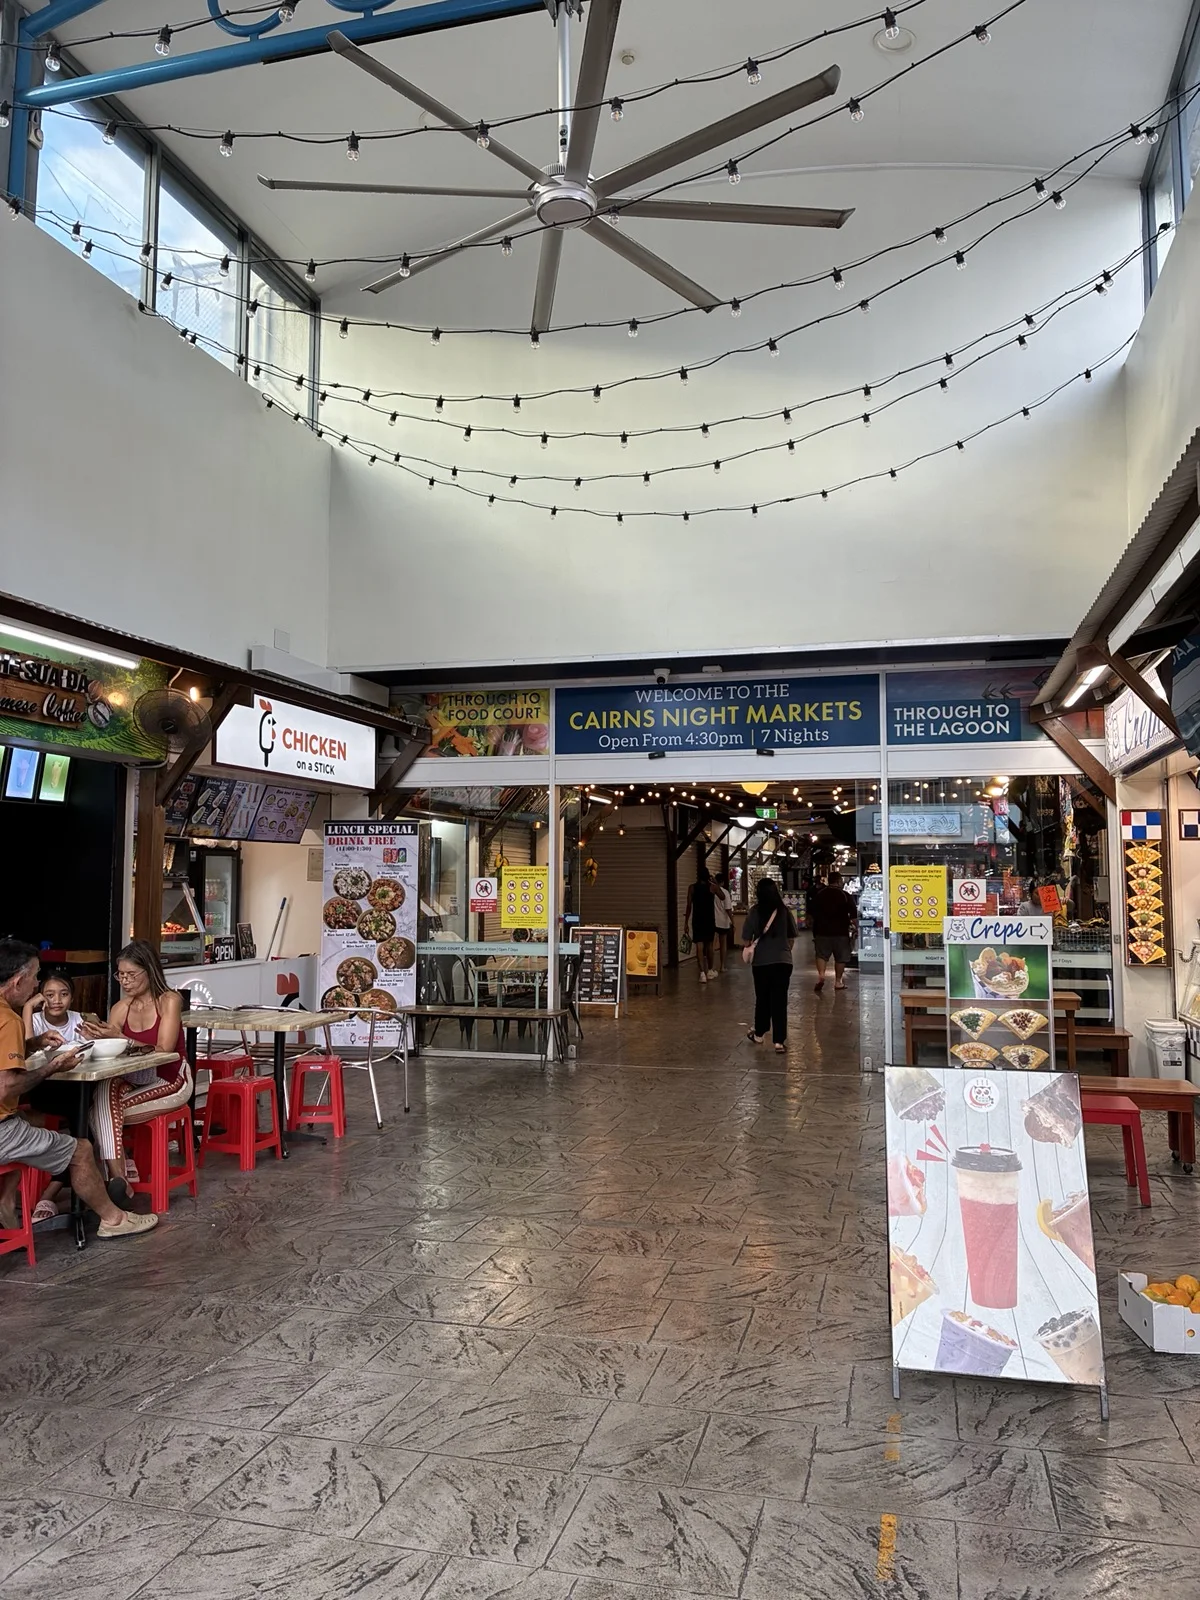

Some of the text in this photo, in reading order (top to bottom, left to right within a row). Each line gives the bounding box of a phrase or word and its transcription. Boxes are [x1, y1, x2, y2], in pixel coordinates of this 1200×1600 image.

[448, 692, 540, 706] THROUGH TO
[635, 684, 790, 703] WELCOME TO THE
[448, 707, 541, 720] FOOD COURT
[570, 701, 862, 730] CAIRNS NIGHT MARKETS
[894, 704, 1010, 720] THROUGH TO
[894, 720, 1010, 736] THE LAGOON
[282, 728, 347, 761] CHICKEN
[598, 728, 830, 750] Open From 4:30pm 7 Nights
[296, 760, 336, 776] on a STICK
[328, 825, 414, 834] LUNCH SPECIAL
[328, 836, 396, 846] DRINK FREE
[970, 918, 1028, 944] Crepe
[215, 945, 234, 960] OPEN
